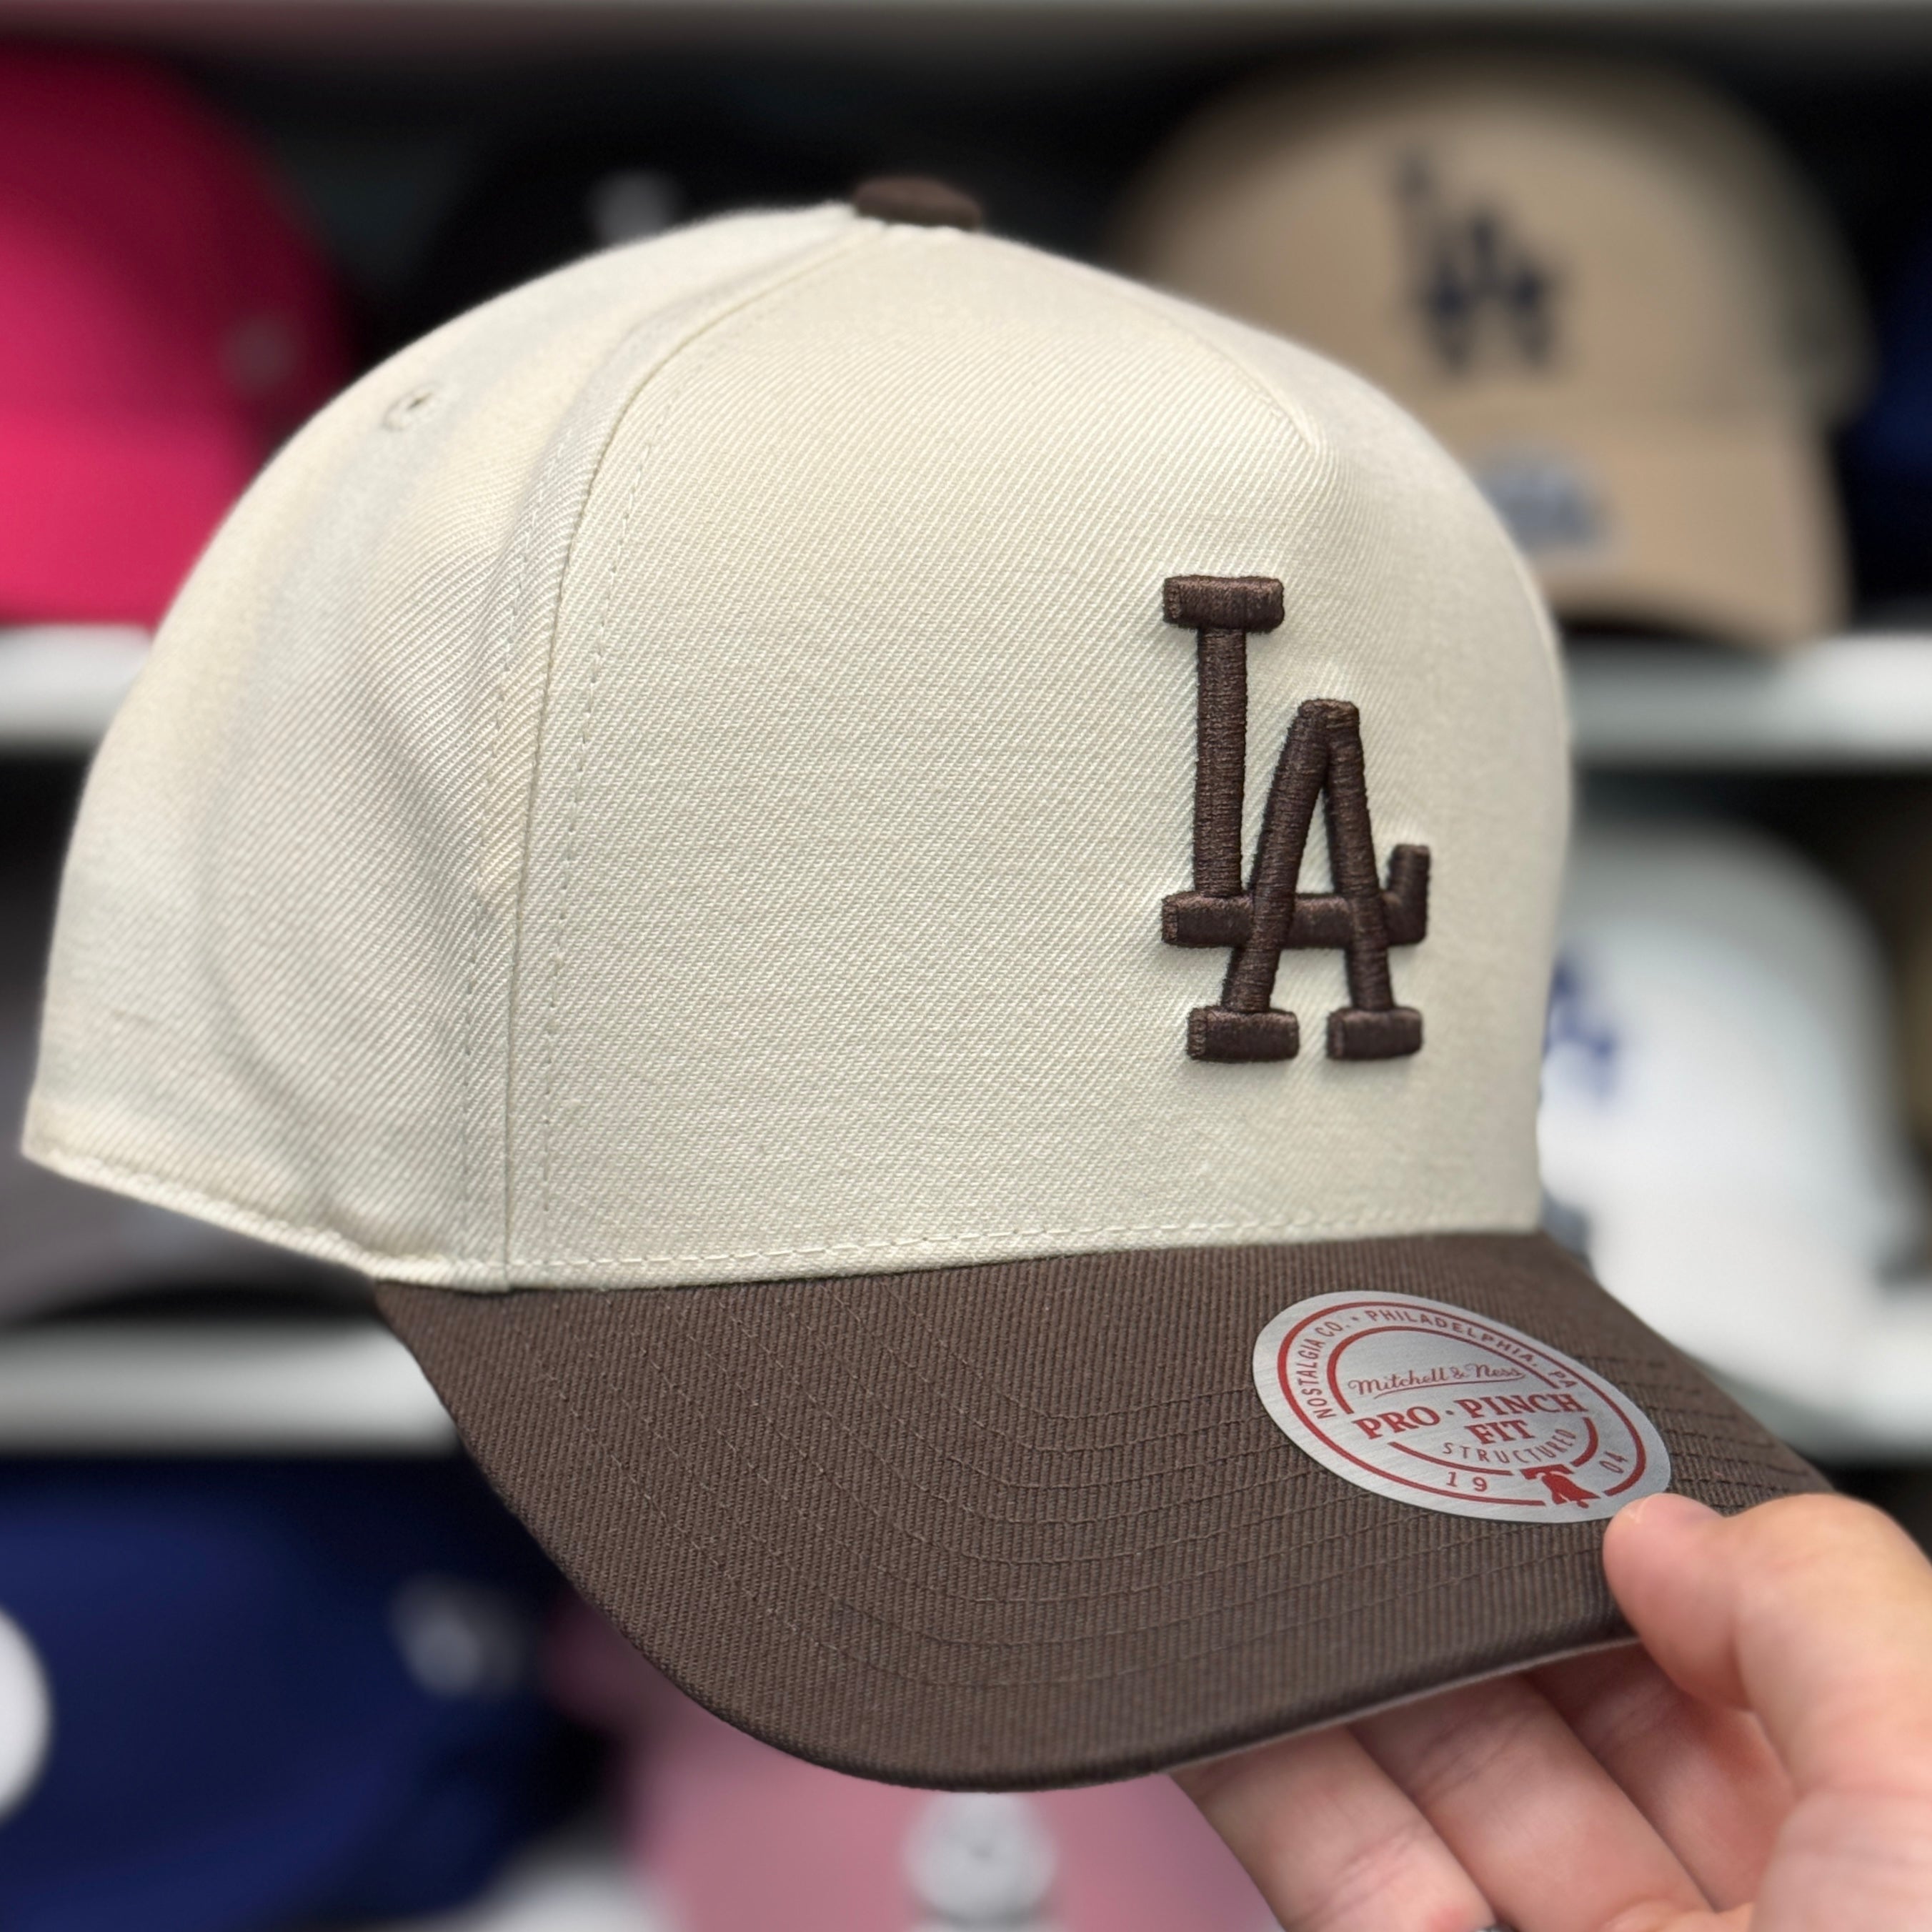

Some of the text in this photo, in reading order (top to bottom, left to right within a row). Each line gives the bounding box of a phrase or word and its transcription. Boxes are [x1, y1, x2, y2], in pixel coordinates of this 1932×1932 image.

[1162, 574, 1431, 1063] LA
[1296, 1338, 1337, 1420] NOSTALGIA
[1548, 1370, 1578, 1388] PA
[1348, 1363, 1523, 1395] Mitchell & Ness
[1350, 1394, 1589, 1440] PRO PINCH
[1464, 1419, 1536, 1445] FIT
[1442, 1428, 1576, 1465] STRUCTURED
